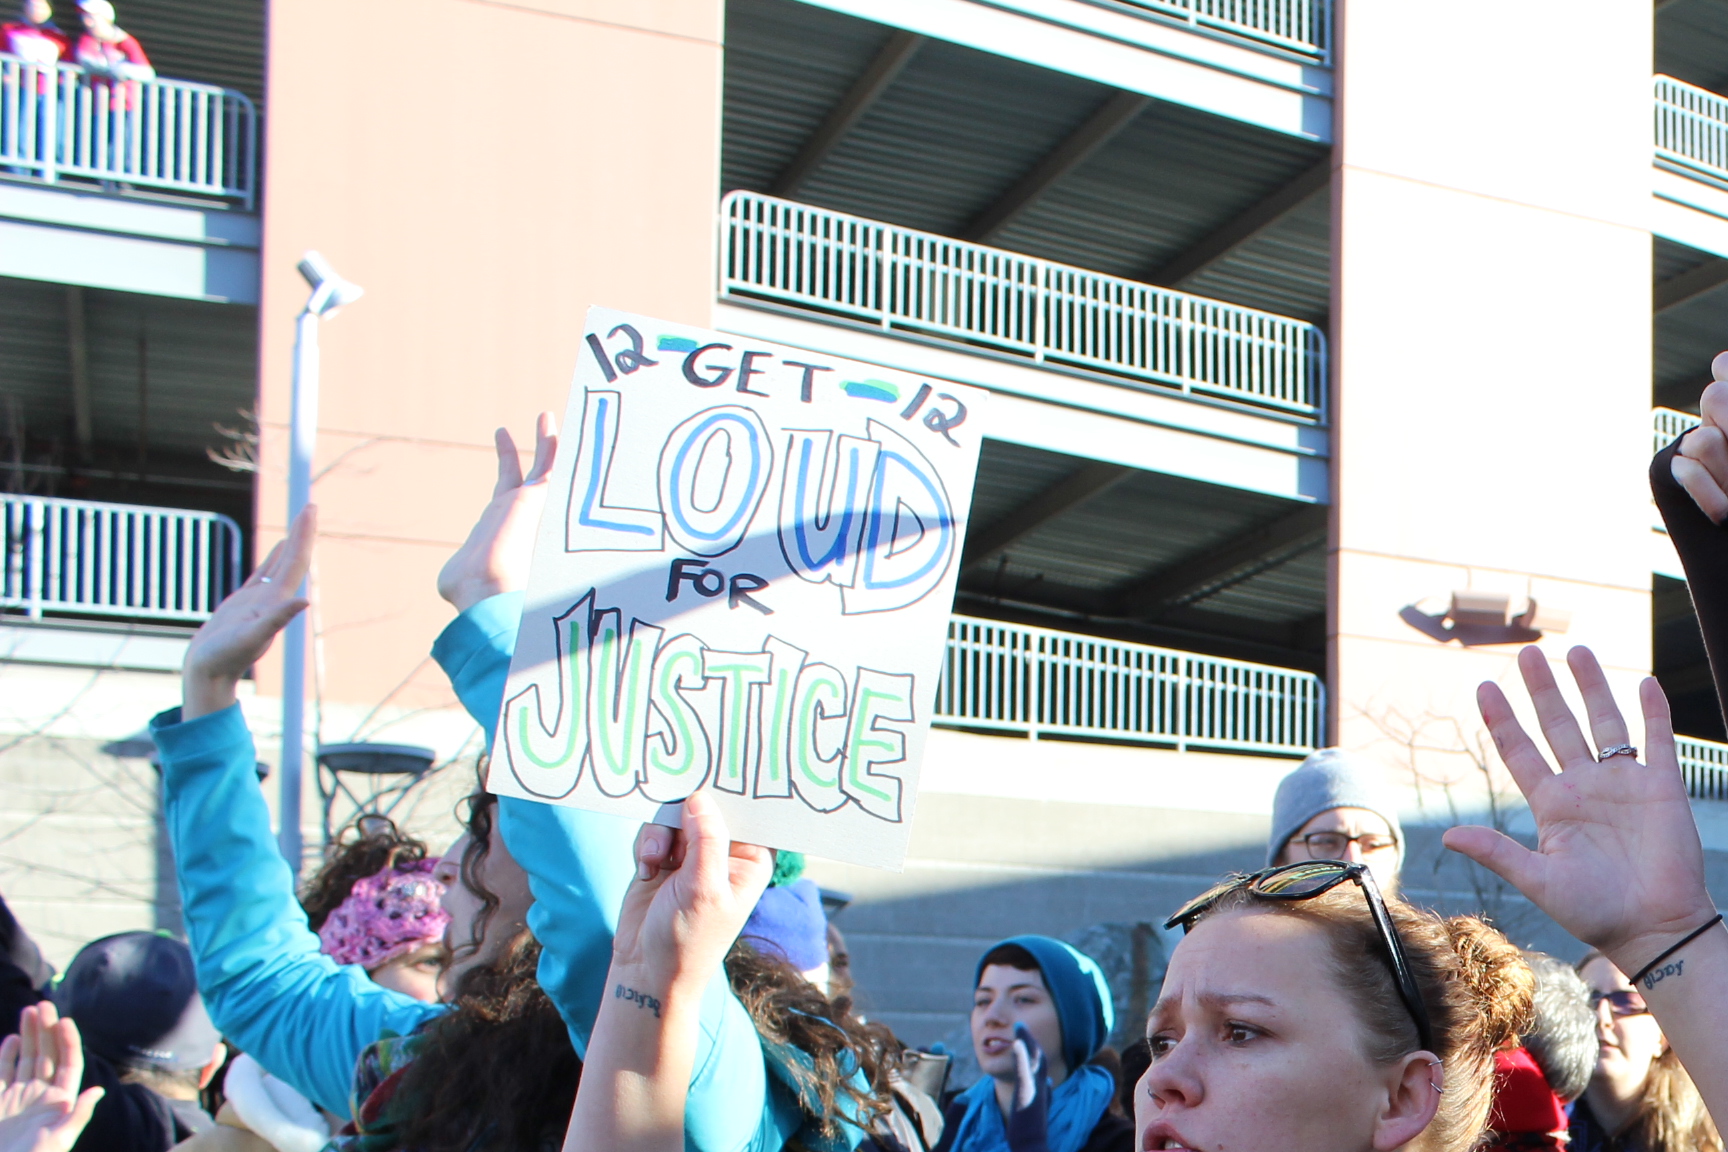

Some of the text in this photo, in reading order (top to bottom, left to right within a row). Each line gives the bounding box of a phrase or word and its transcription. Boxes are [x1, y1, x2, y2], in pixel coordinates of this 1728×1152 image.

[586, 325, 966, 447] 12 GET 12
[566, 387, 955, 614] LOUD
[666, 558, 774, 614] FOR
[504, 588, 914, 823] JUSTICE
